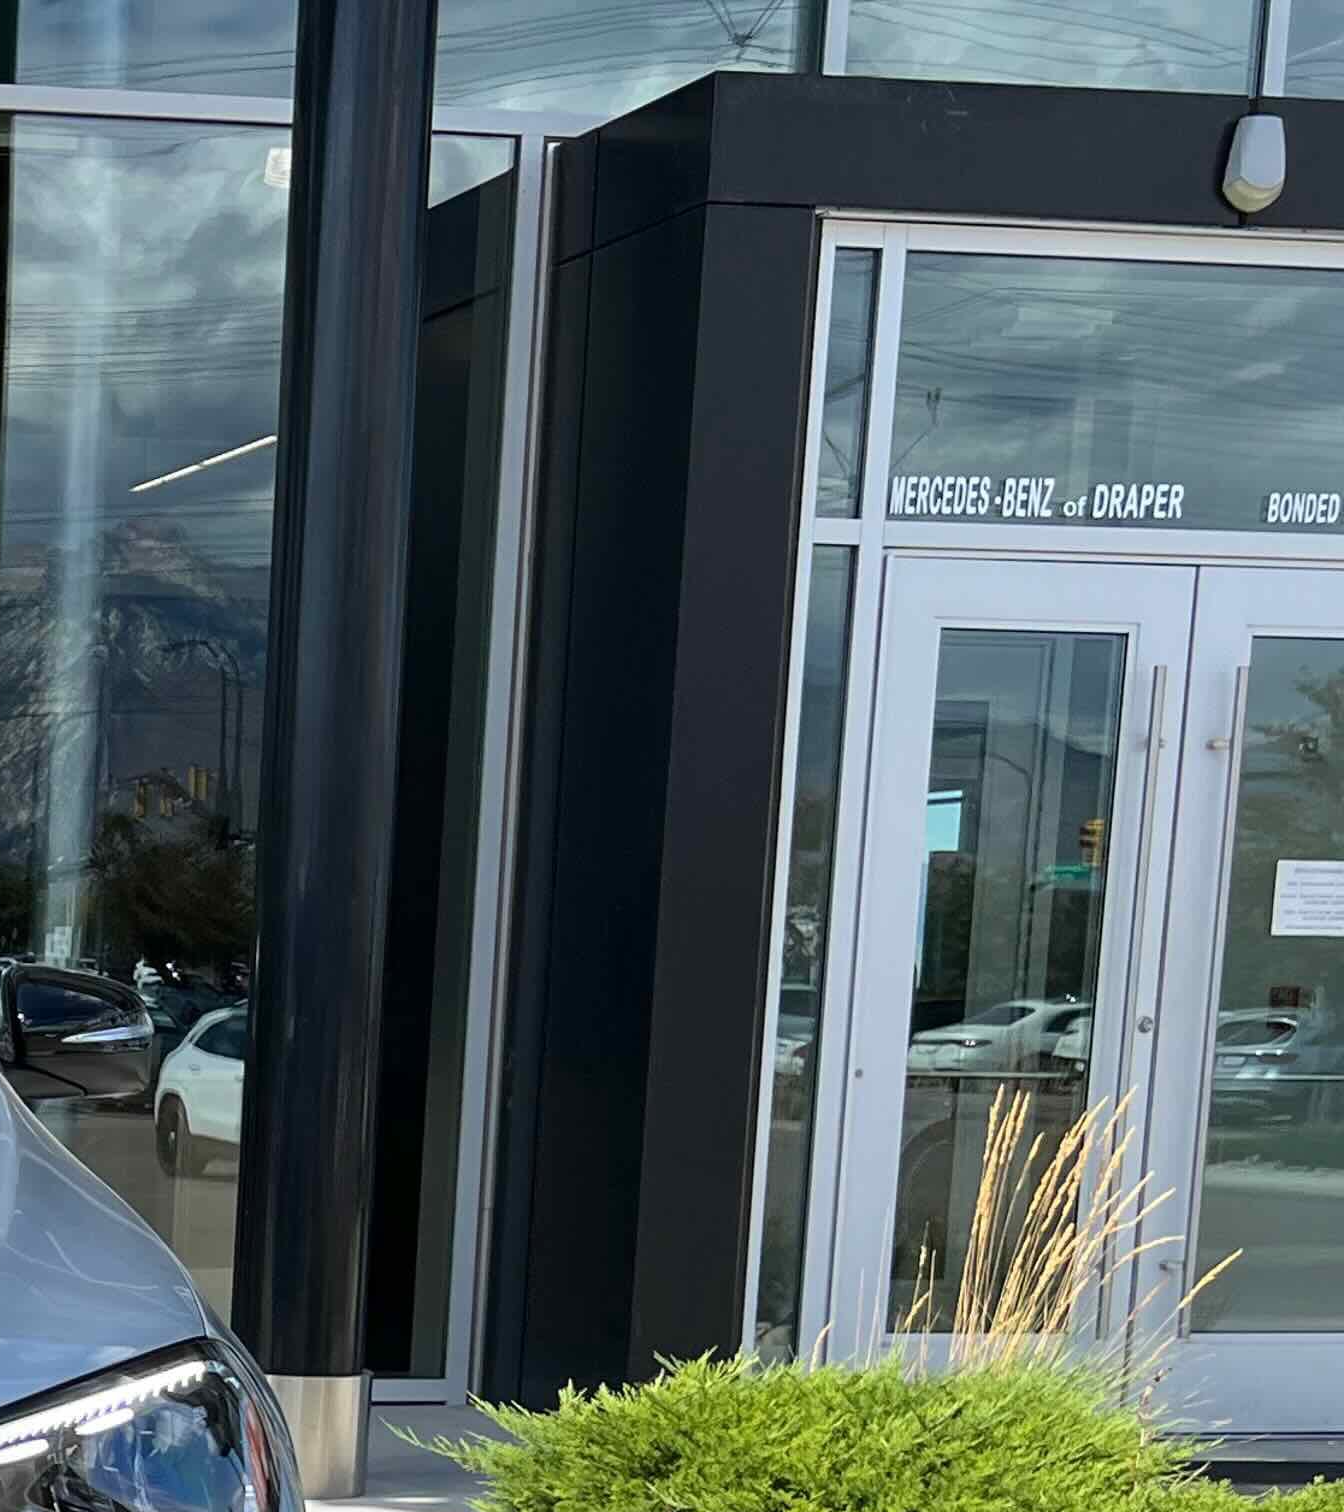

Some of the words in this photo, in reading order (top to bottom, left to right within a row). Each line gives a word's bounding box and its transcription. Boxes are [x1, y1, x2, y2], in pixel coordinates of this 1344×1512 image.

[1063, 496, 1086, 517] of
[1092, 484, 1184, 519] DRAPER
[1267, 492, 1340, 523] BONDED
